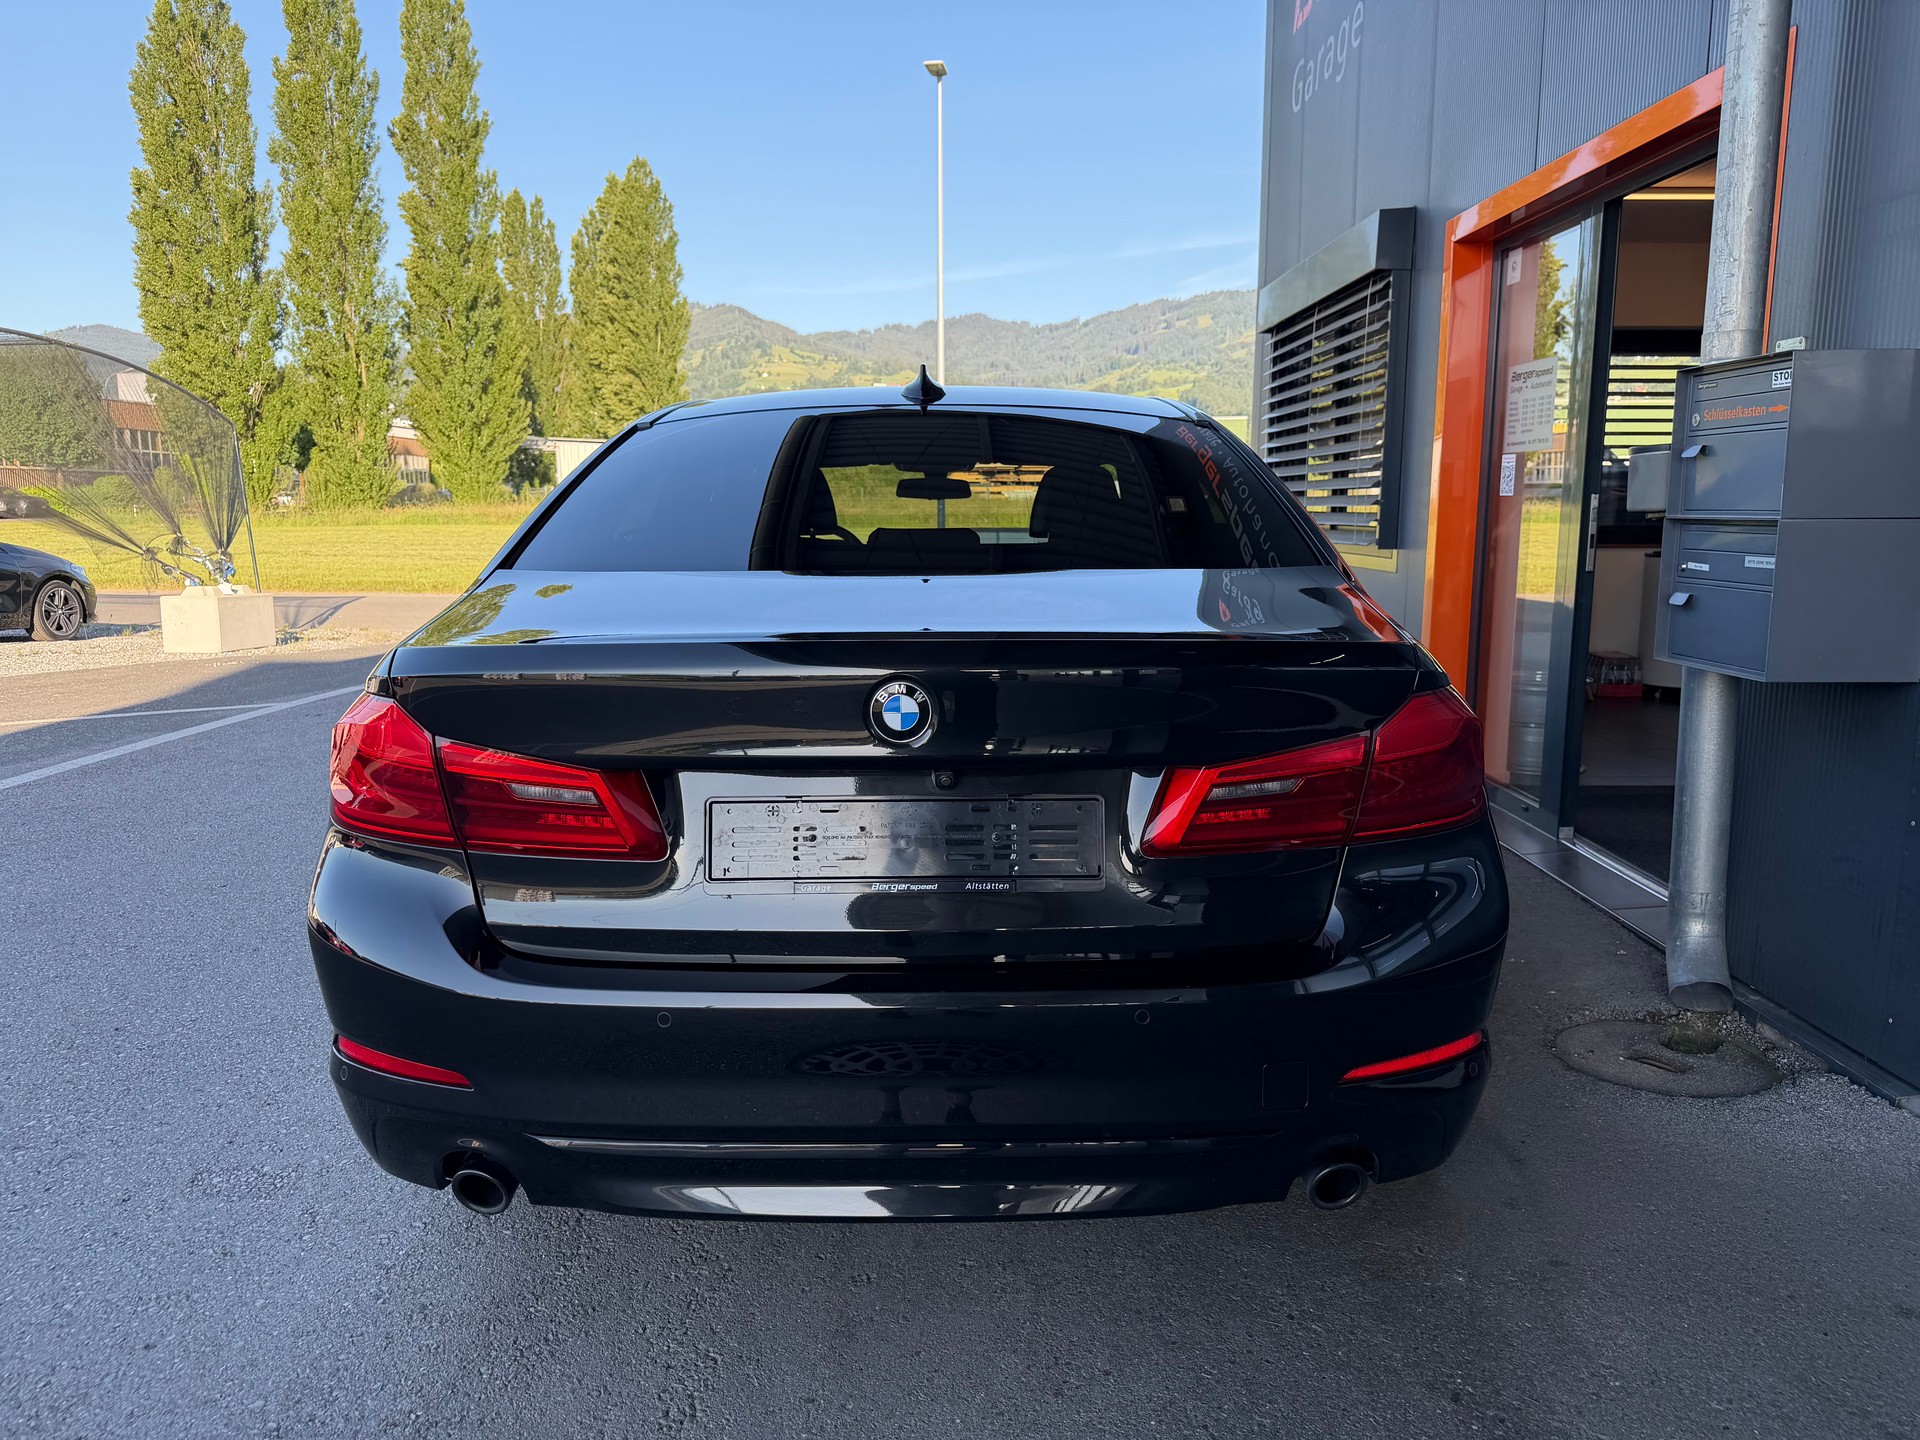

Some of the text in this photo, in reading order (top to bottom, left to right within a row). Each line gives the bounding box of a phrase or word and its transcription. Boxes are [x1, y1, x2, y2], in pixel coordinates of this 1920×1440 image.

[1292, 1, 1364, 113] Garage
[1704, 405, 1766, 421] Schlüsselkasten
[877, 684, 926, 704] BMW
[801, 882, 1010, 893] Garage Bergerspeed Altstätten
